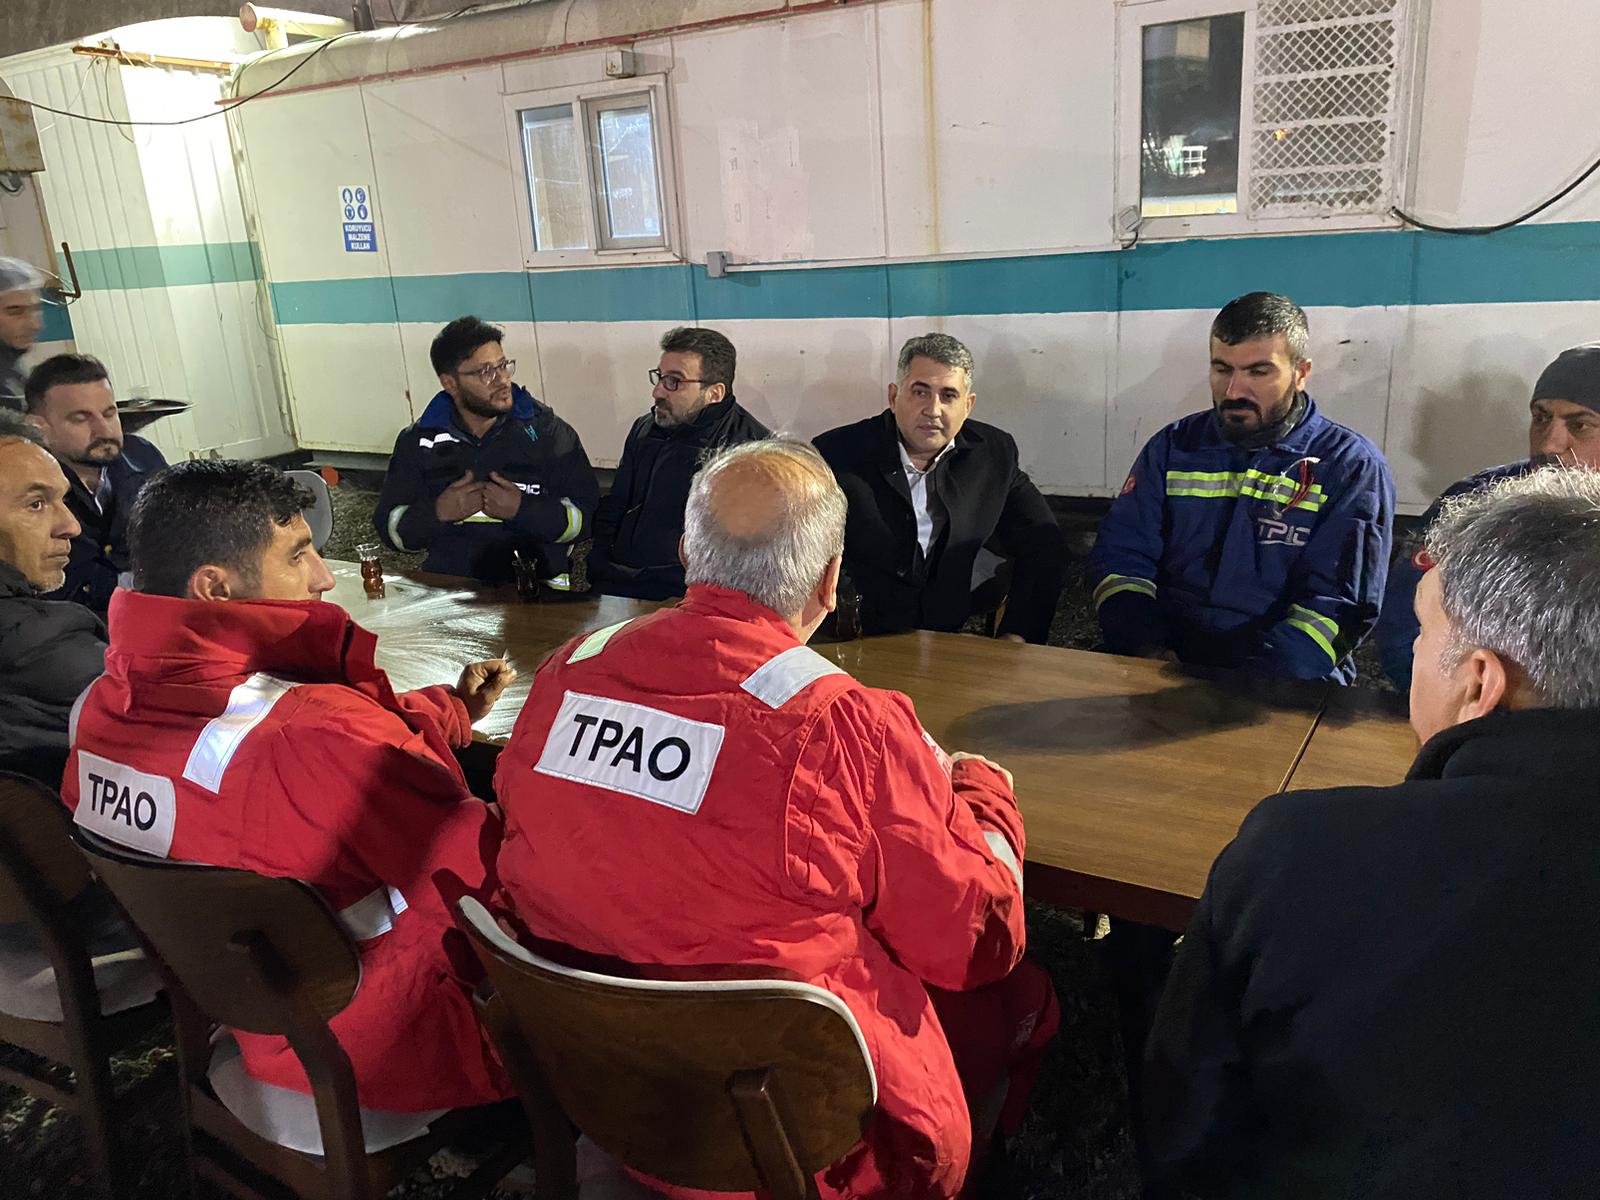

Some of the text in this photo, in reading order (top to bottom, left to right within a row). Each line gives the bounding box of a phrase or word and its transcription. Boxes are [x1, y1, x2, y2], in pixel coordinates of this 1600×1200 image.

[512, 481, 541, 495] PIC
[1258, 518, 1311, 546] TPIC
[568, 714, 691, 782] TPAO
[88, 772, 157, 831] TPAO
